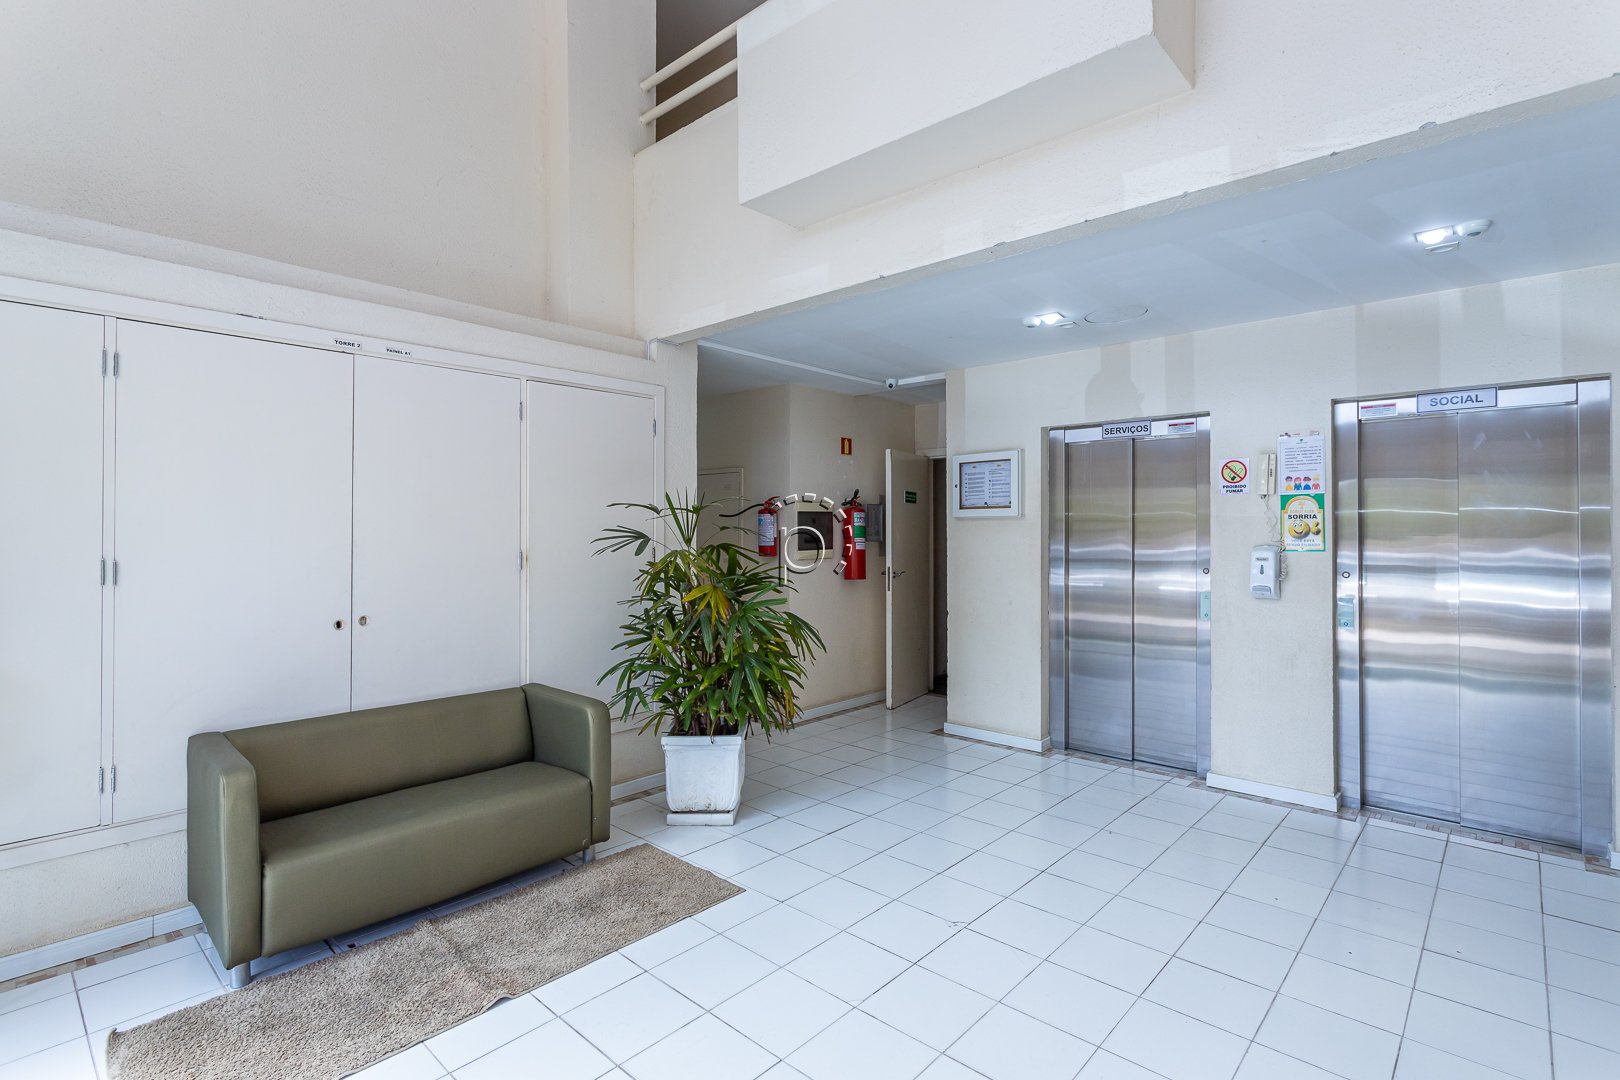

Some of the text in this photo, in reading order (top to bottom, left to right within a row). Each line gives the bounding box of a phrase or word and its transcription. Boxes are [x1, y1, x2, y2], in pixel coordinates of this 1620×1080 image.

[334, 340, 356, 348] TORRE
[1429, 394, 1484, 407] SOCIAL
[1104, 424, 1149, 436] SERVIÇOS
